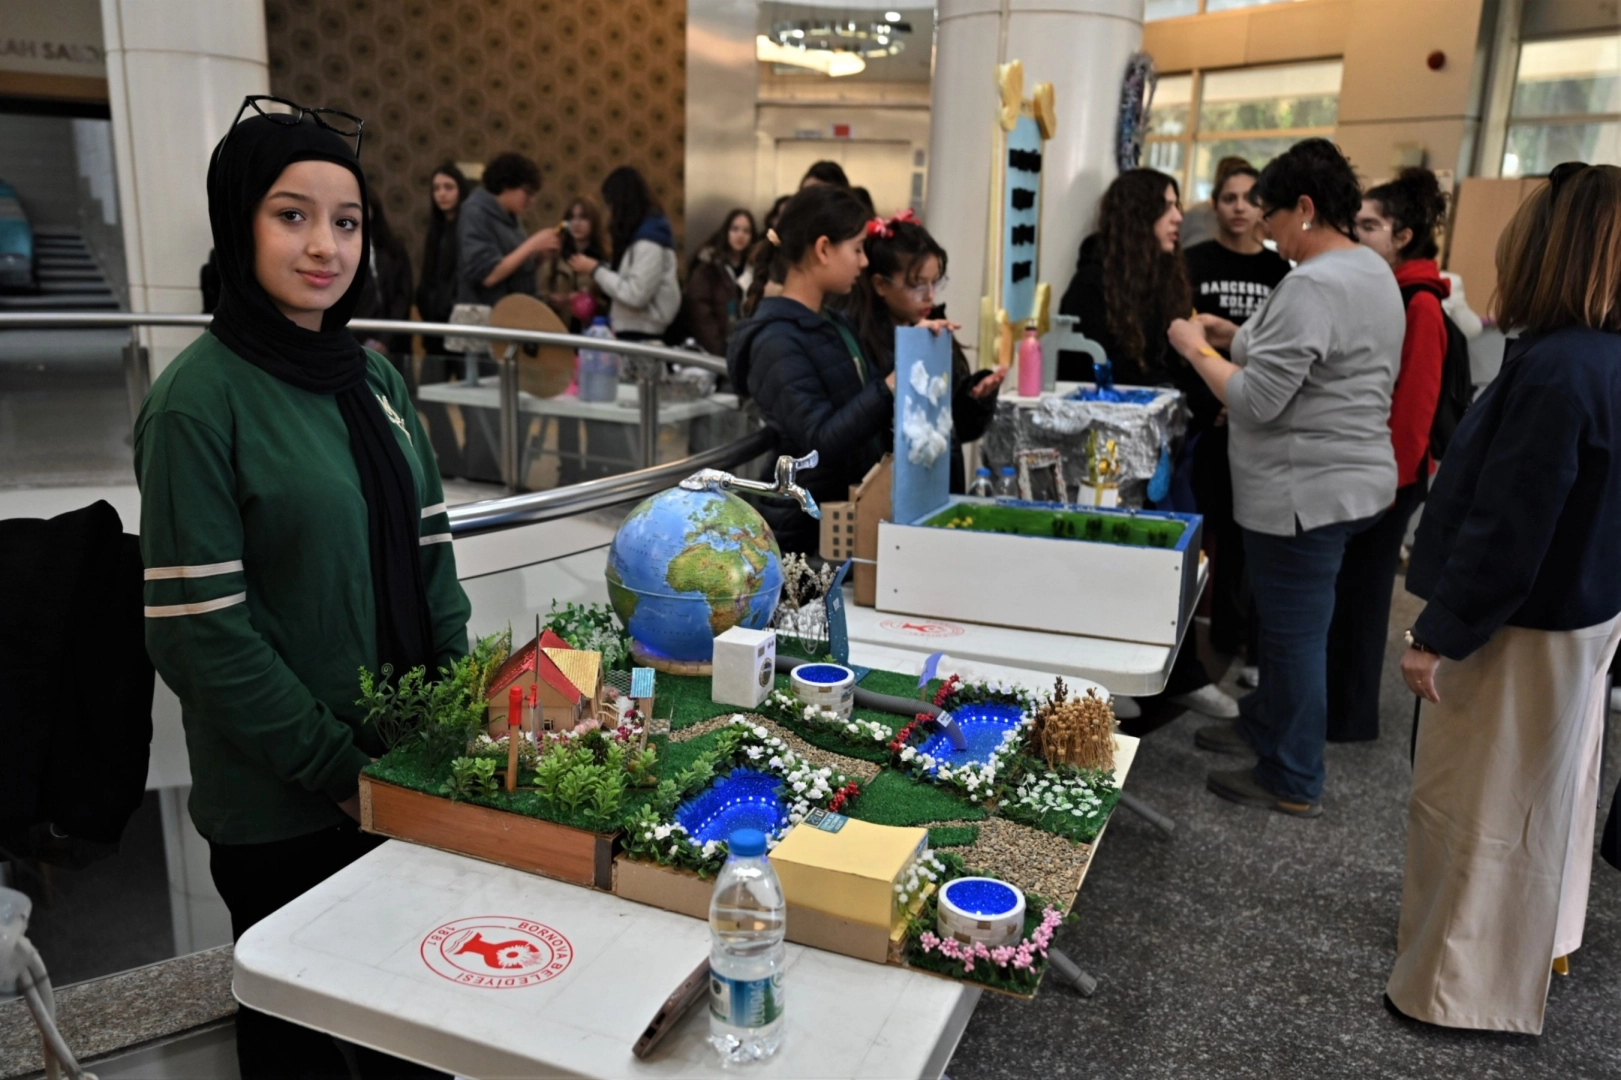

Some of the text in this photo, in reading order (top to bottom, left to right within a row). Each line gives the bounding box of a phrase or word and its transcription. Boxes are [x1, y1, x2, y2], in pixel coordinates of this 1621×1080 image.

[427, 926, 455, 946] 1881
[455, 921, 568, 988] BORNOVA BELEDİYESİ
